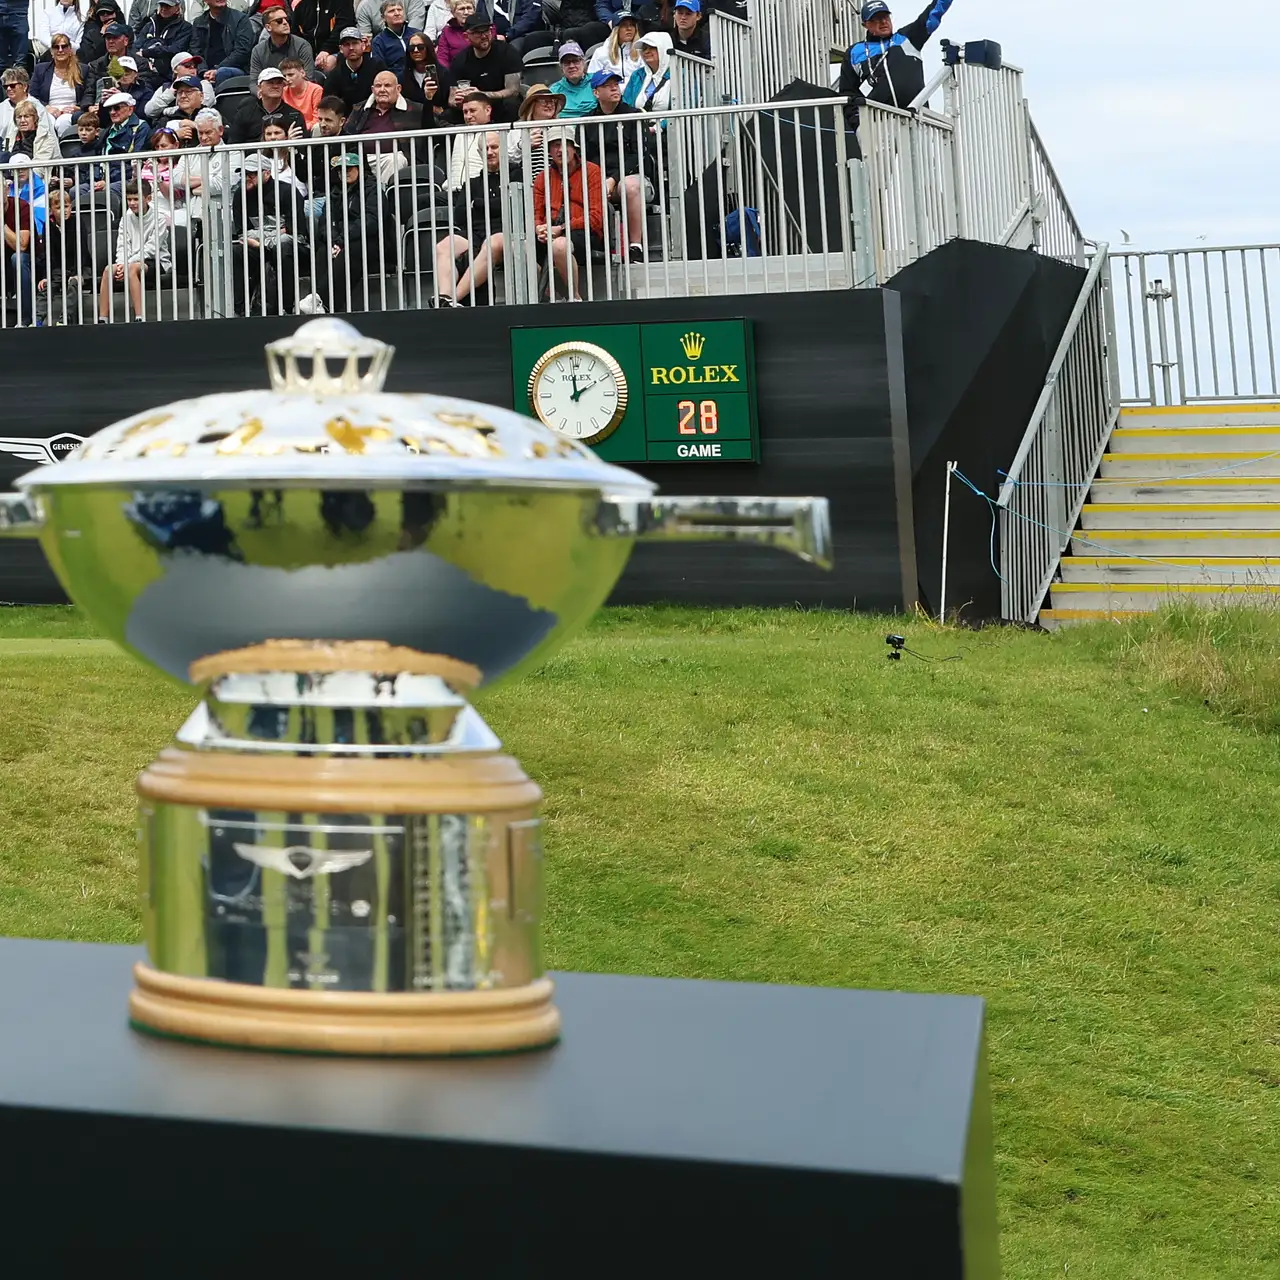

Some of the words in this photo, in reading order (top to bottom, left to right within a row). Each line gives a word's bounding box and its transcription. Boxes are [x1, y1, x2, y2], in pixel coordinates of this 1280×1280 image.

[561, 374, 591, 382] ROLEX
[650, 365, 740, 385] ROLEX
[678, 400, 718, 435] 28
[677, 444, 722, 458] GAME
